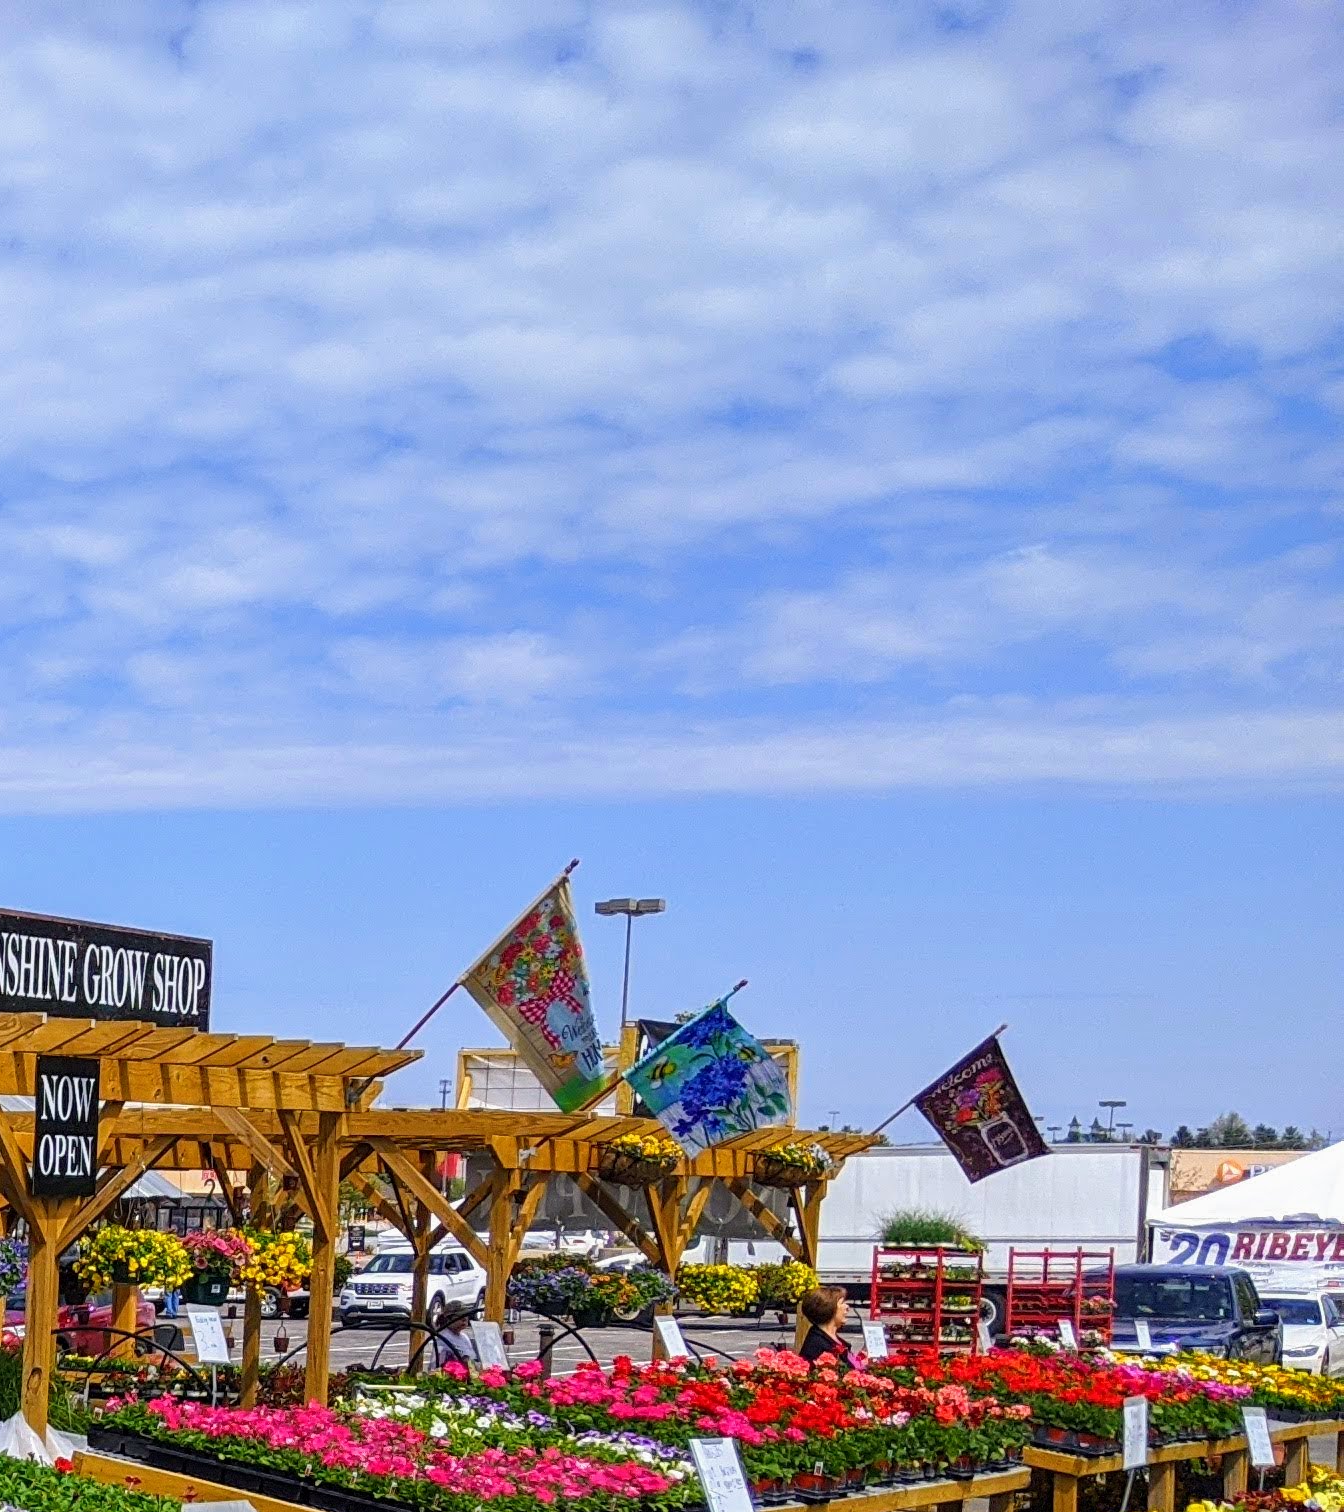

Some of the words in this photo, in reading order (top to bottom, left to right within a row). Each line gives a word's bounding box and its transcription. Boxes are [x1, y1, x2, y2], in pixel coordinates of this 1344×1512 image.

[83, 943, 150, 1011] GROW
[152, 953, 206, 1016] SHOP
[40, 1074, 96, 1123] NOW
[38, 1134, 94, 1177] OPEN
